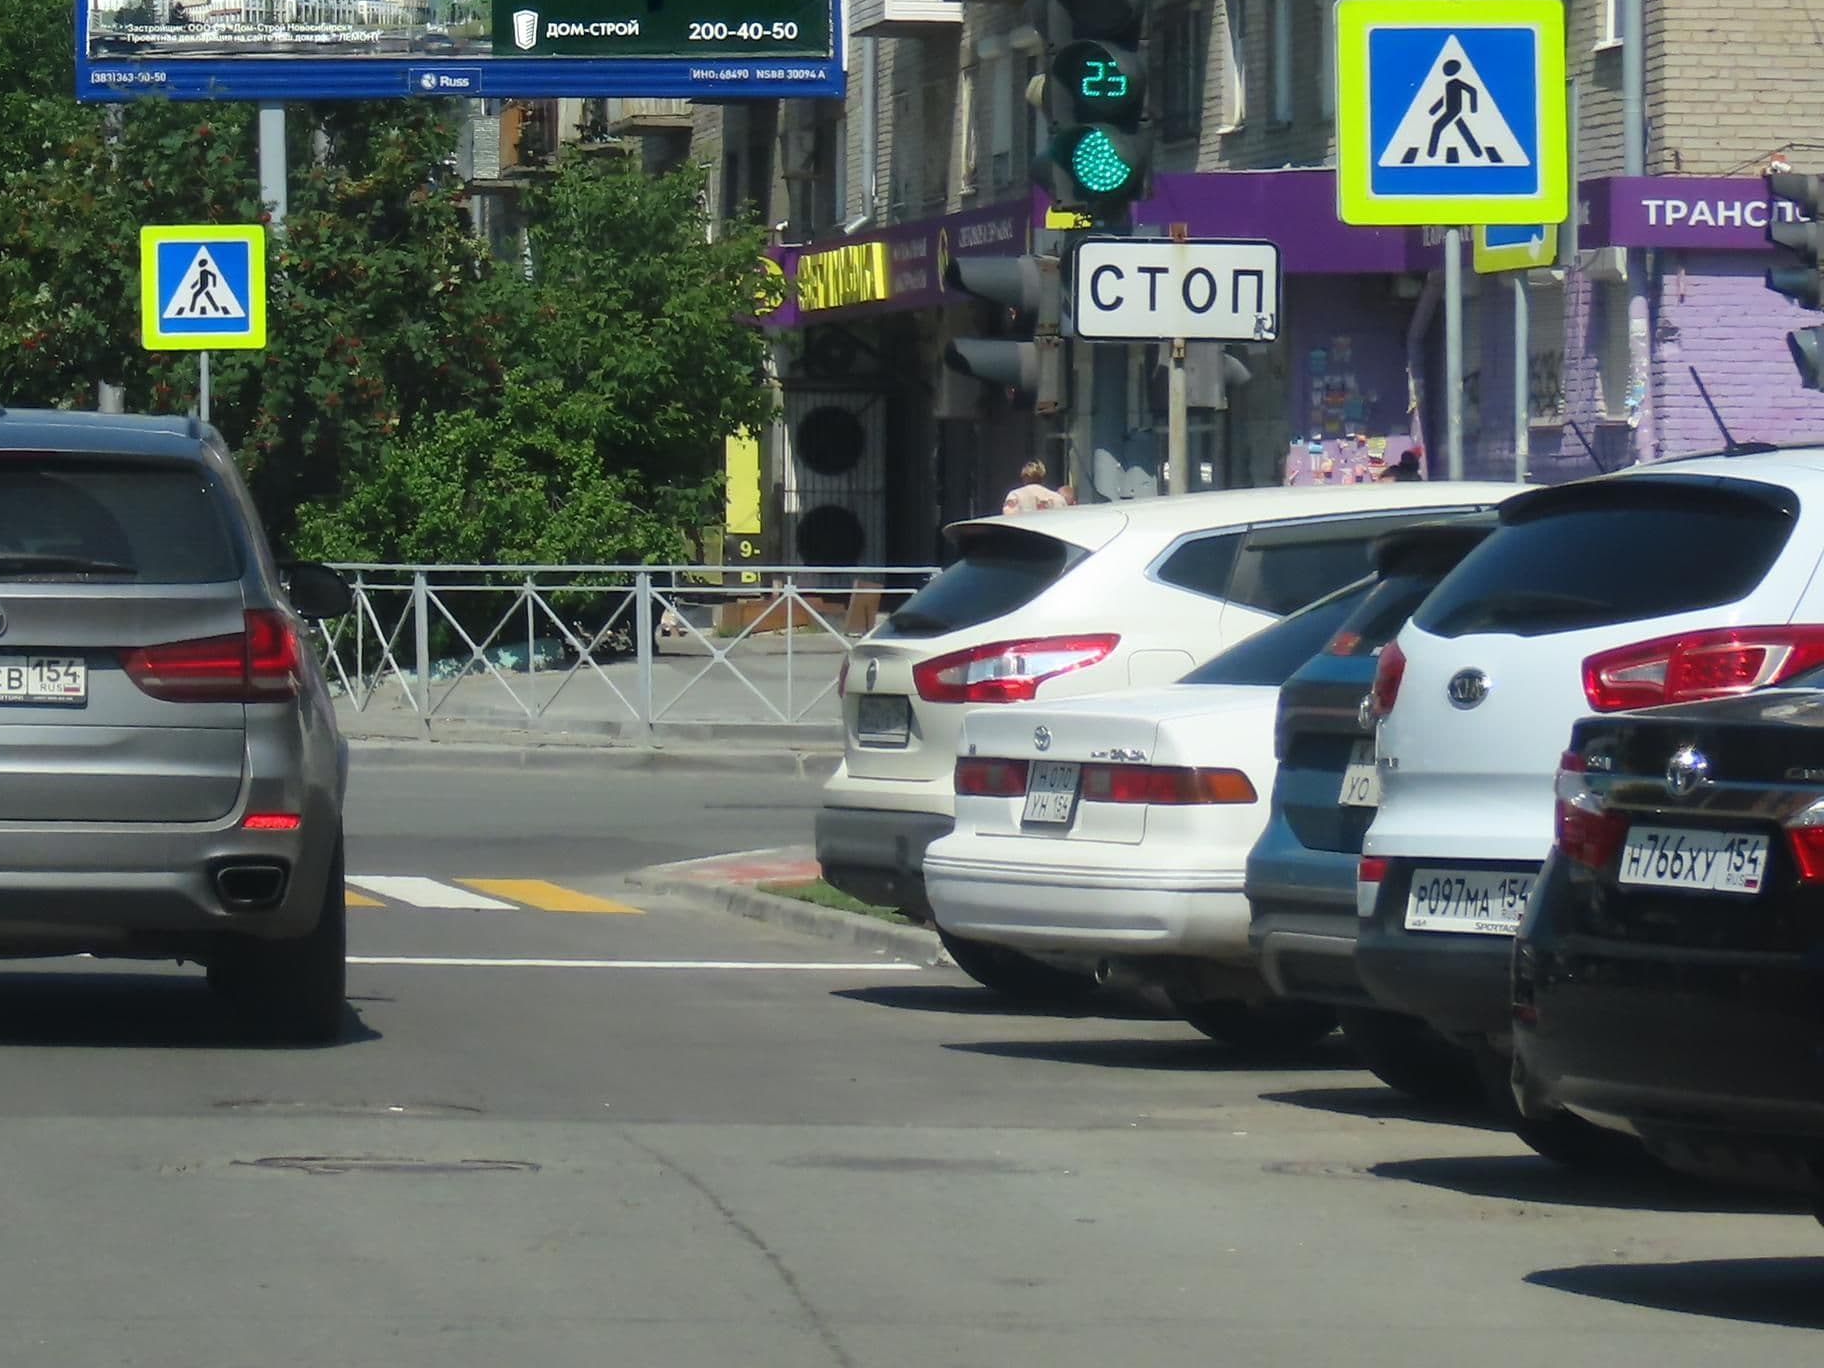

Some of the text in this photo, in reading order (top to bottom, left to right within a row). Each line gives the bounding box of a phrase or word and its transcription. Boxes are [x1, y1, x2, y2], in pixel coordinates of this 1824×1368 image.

[546, 19, 640, 39] ДОМ-СТРОЙ
[688, 22, 799, 41] 200-40-50
[439, 75, 470, 87] Russ
[1090, 264, 1264, 315] СТОП
[32, 659, 79, 683] 154
[40, 683, 63, 692] RUS
[1724, 838, 1761, 874] 154
